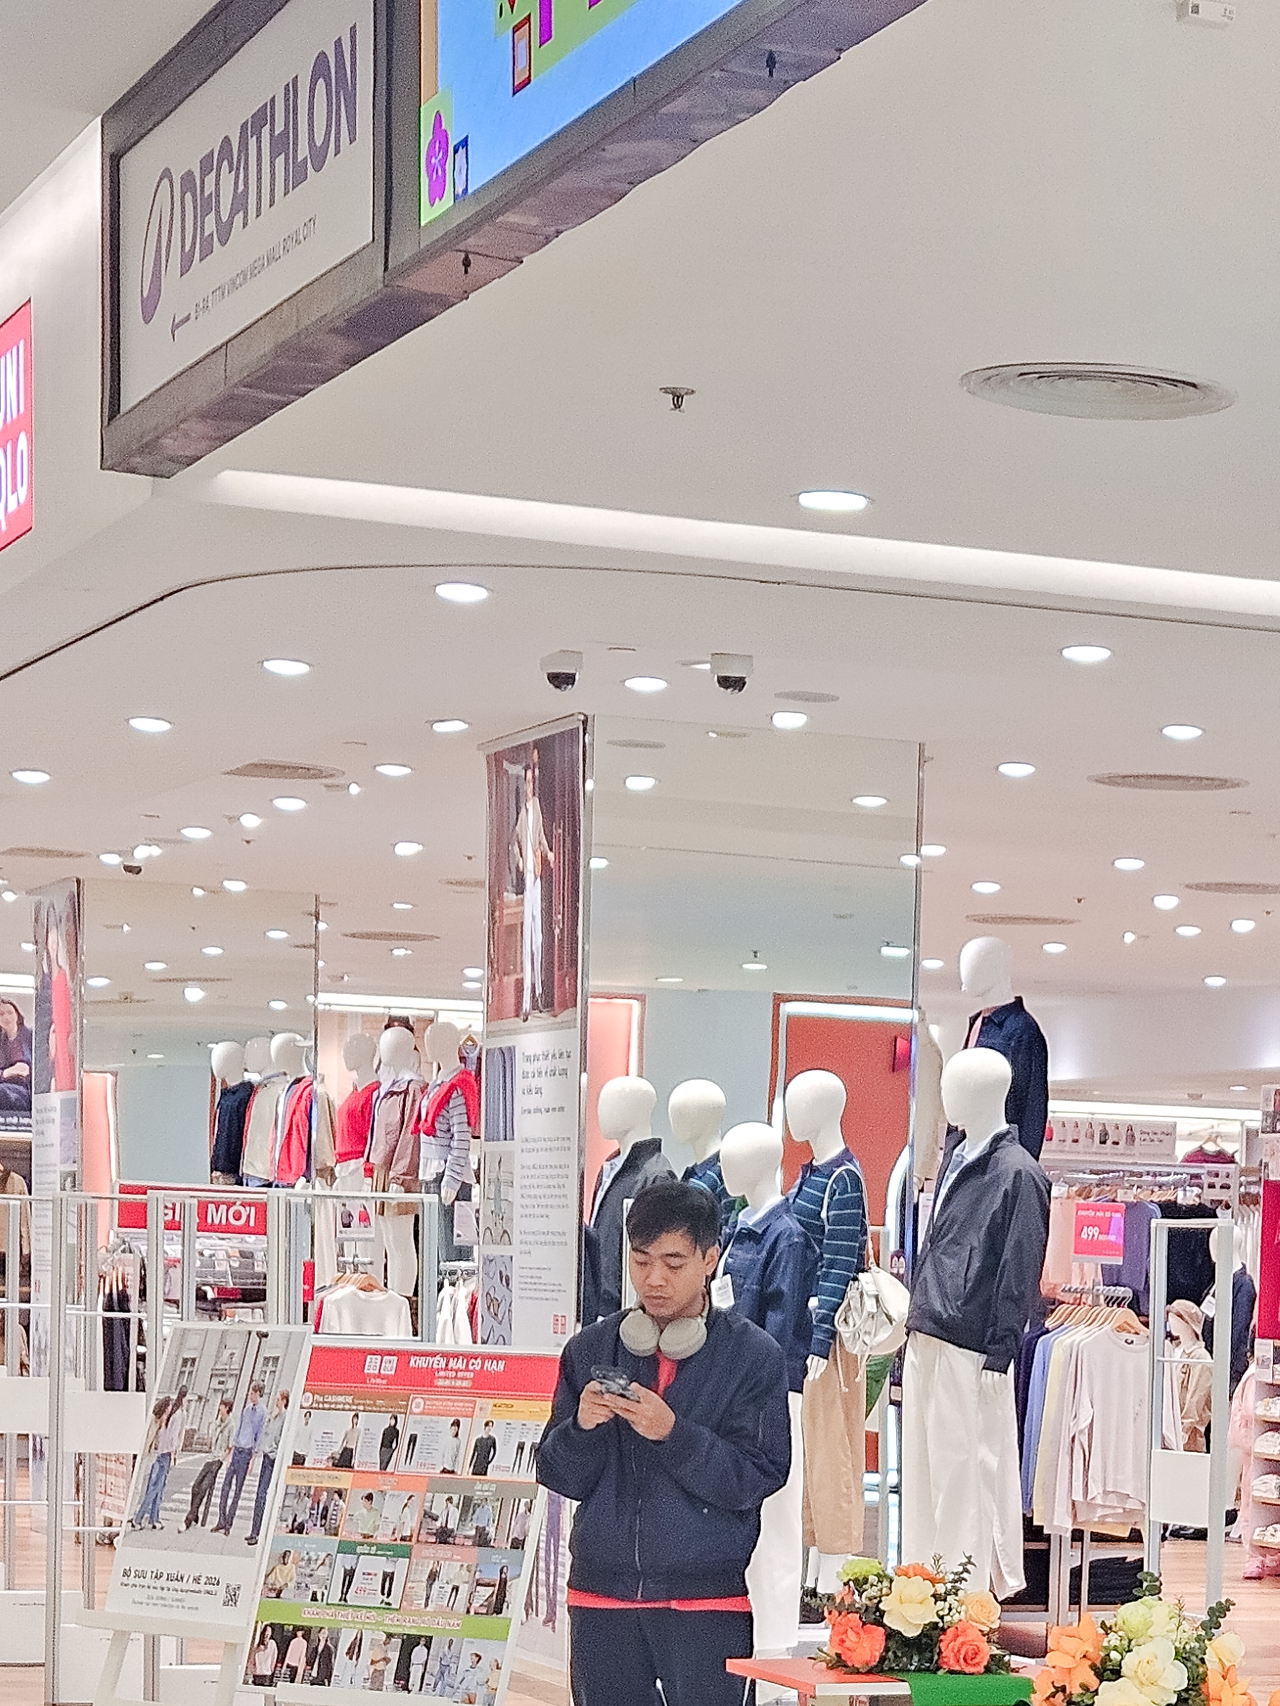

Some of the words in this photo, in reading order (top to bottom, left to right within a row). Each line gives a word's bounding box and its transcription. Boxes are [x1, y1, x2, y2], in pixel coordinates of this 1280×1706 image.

[180, 22, 357, 278] DECATHLON
[302, 214, 317, 242] CITY
[206, 1200, 256, 1227] MỚI
[1080, 1225, 1100, 1241] 499
[410, 1353, 447, 1370] KHUYẾN
[449, 1357, 466, 1371] MÃI
[468, 1357, 483, 1371] CÓ
[484, 1360, 506, 1375] HẠN
[133, 1569, 148, 1580] SƯU
[149, 1571, 164, 1584] TẬP
